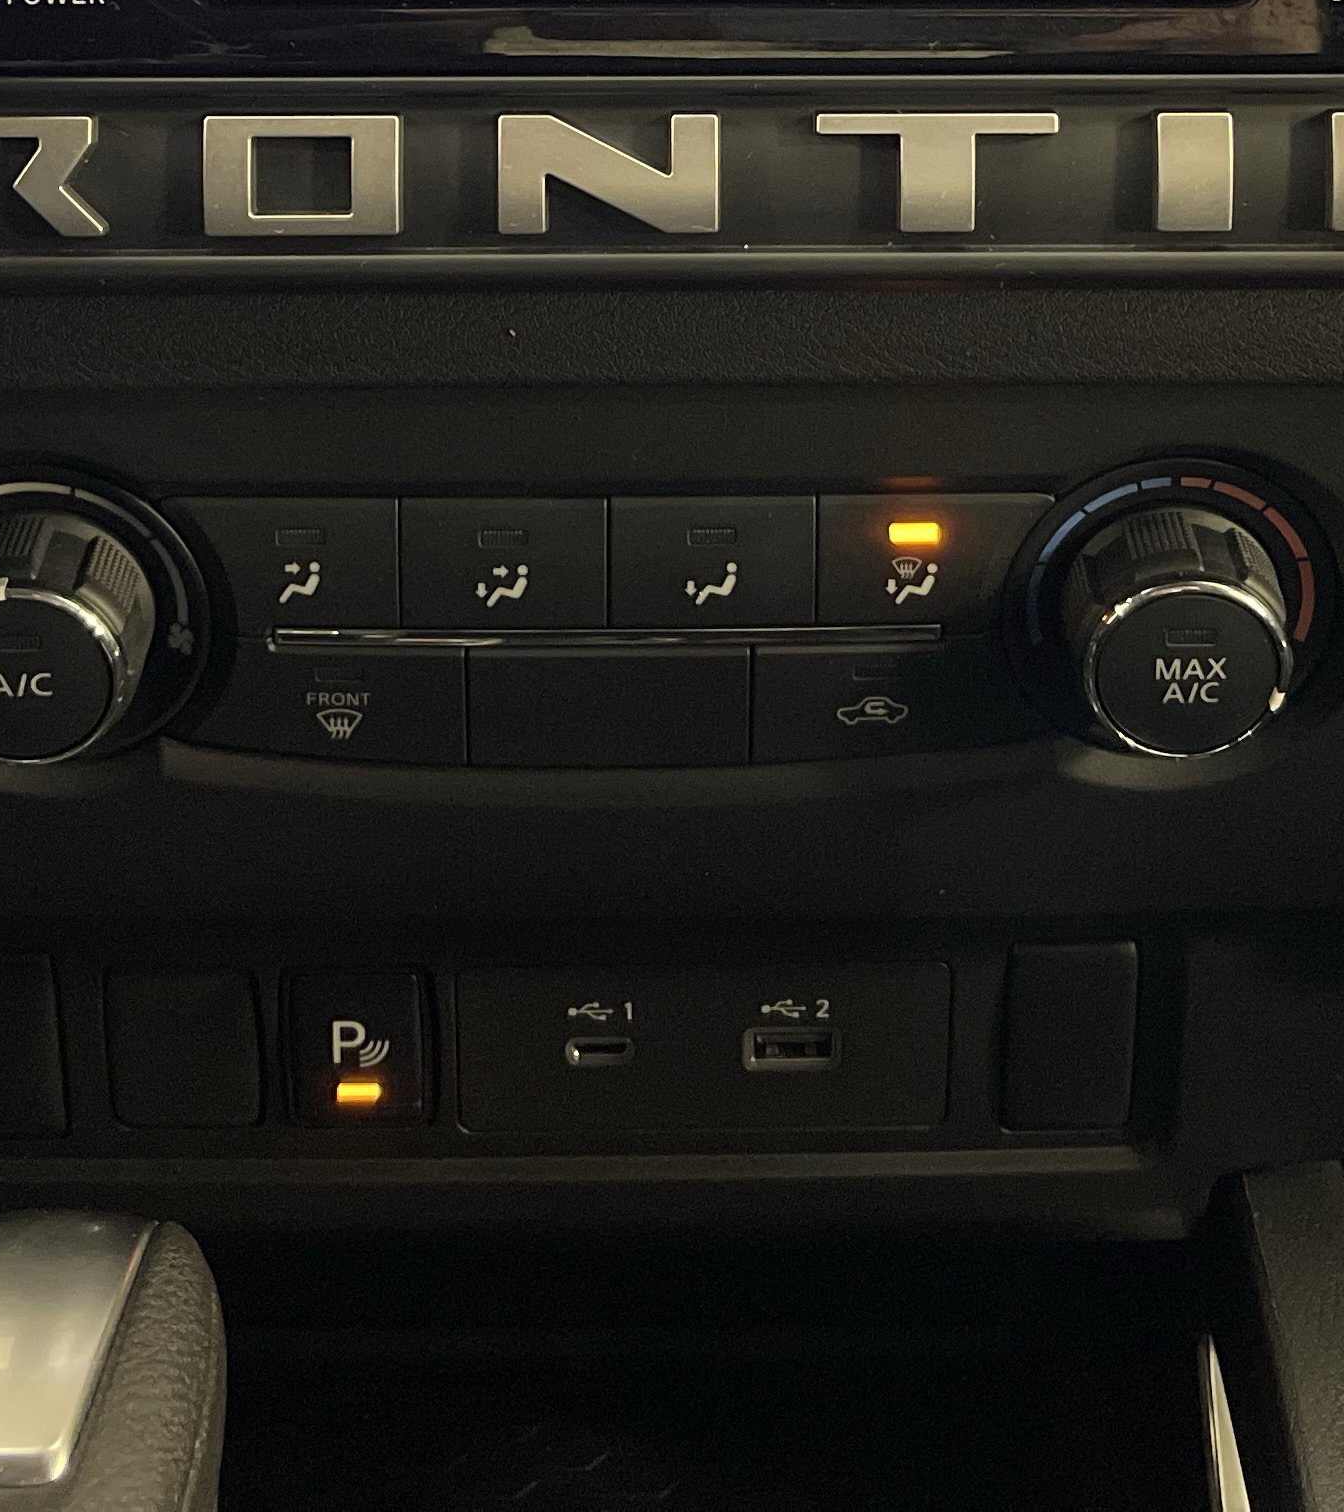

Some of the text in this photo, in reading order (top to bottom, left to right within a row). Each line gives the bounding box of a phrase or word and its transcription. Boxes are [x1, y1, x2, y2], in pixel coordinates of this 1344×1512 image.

[1154, 657, 1227, 681] MAX
[305, 691, 371, 706] FRONT
[1162, 682, 1221, 705] A/C
[815, 999, 830, 1019] 2
[332, 1021, 366, 1064] P
